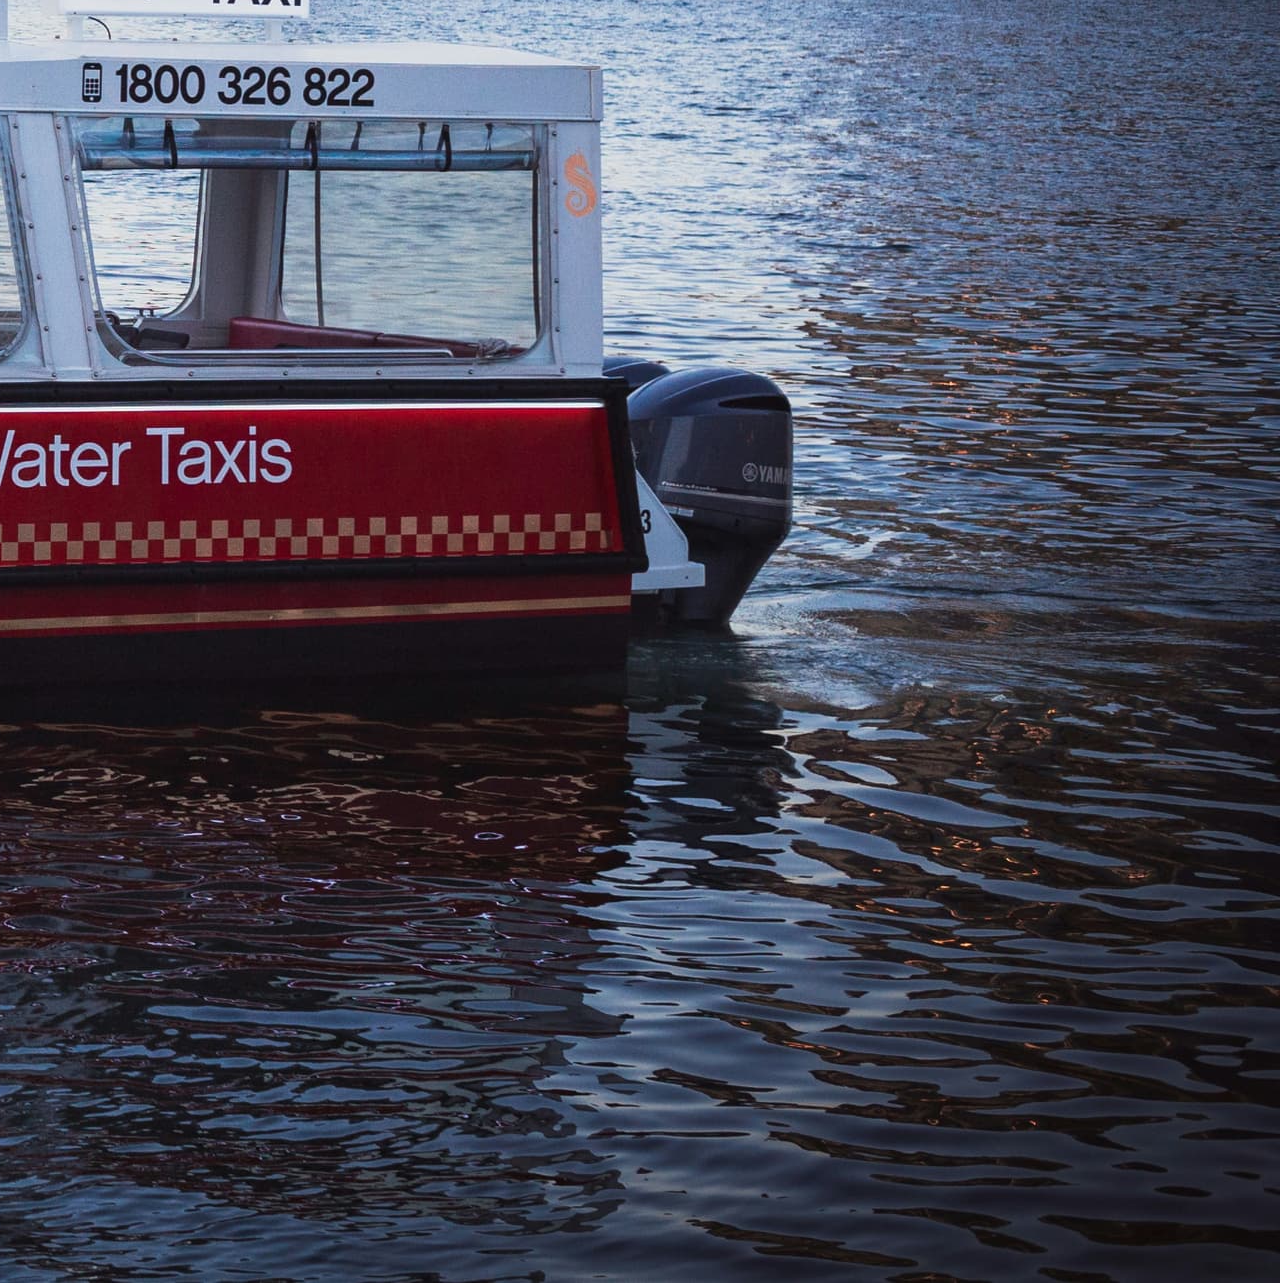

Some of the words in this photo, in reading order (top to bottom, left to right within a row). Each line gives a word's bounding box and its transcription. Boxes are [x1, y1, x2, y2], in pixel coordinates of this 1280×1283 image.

[115, 63, 206, 105] 1800
[217, 66, 291, 107] 326
[303, 67, 375, 108] 822
[146, 424, 293, 485] Taxis
